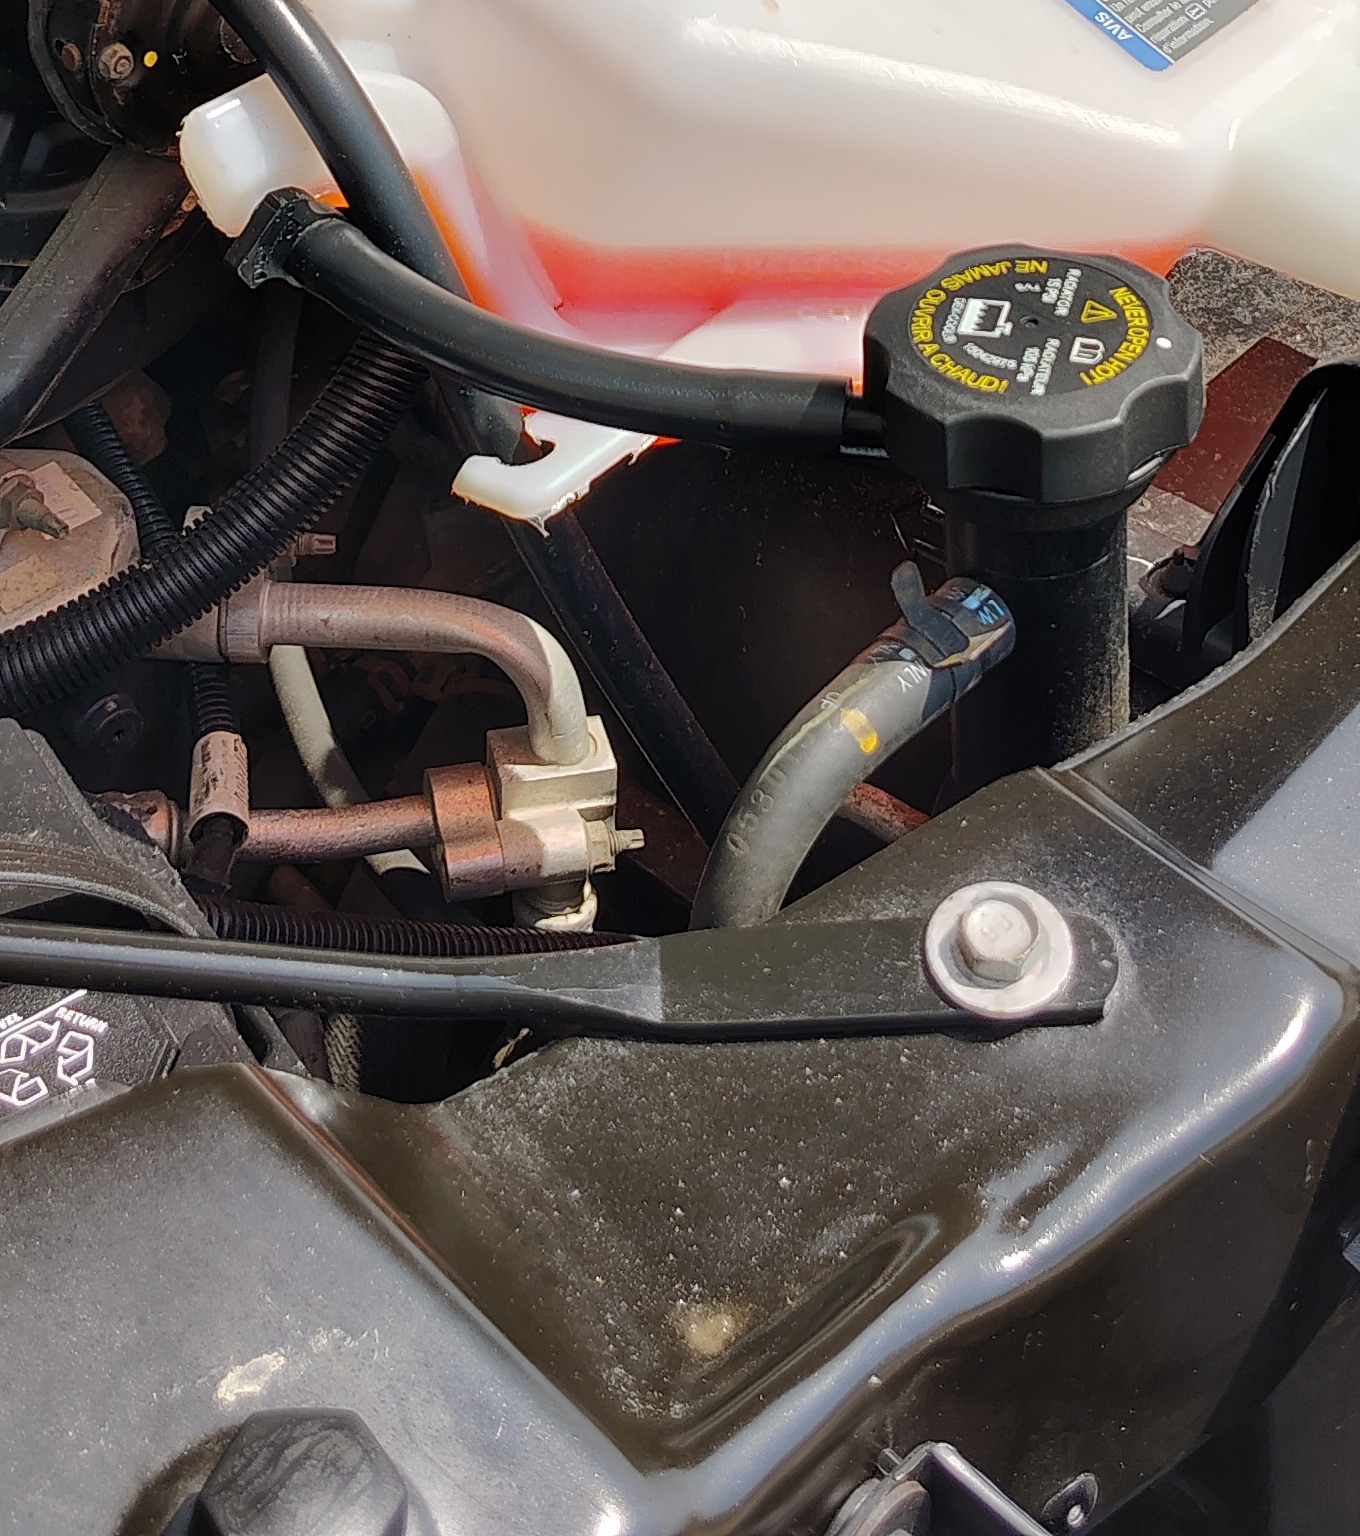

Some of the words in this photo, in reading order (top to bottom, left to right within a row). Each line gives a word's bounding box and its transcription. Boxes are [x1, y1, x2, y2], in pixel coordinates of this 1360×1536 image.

[1095, 11, 1133, 41] AVIS
[941, 260, 1012, 291] JAMAIS
[1014, 259, 1048, 274] NE
[1054, 268, 1082, 316] RADIATOR
[1108, 287, 1148, 327] NEVER
[911, 289, 946, 343] OUVRIR
[918, 343, 939, 357] A
[1113, 327, 1149, 363] OPEN
[930, 353, 1009, 394] CHAUD!
[55, 1007, 110, 1034] RETURN
